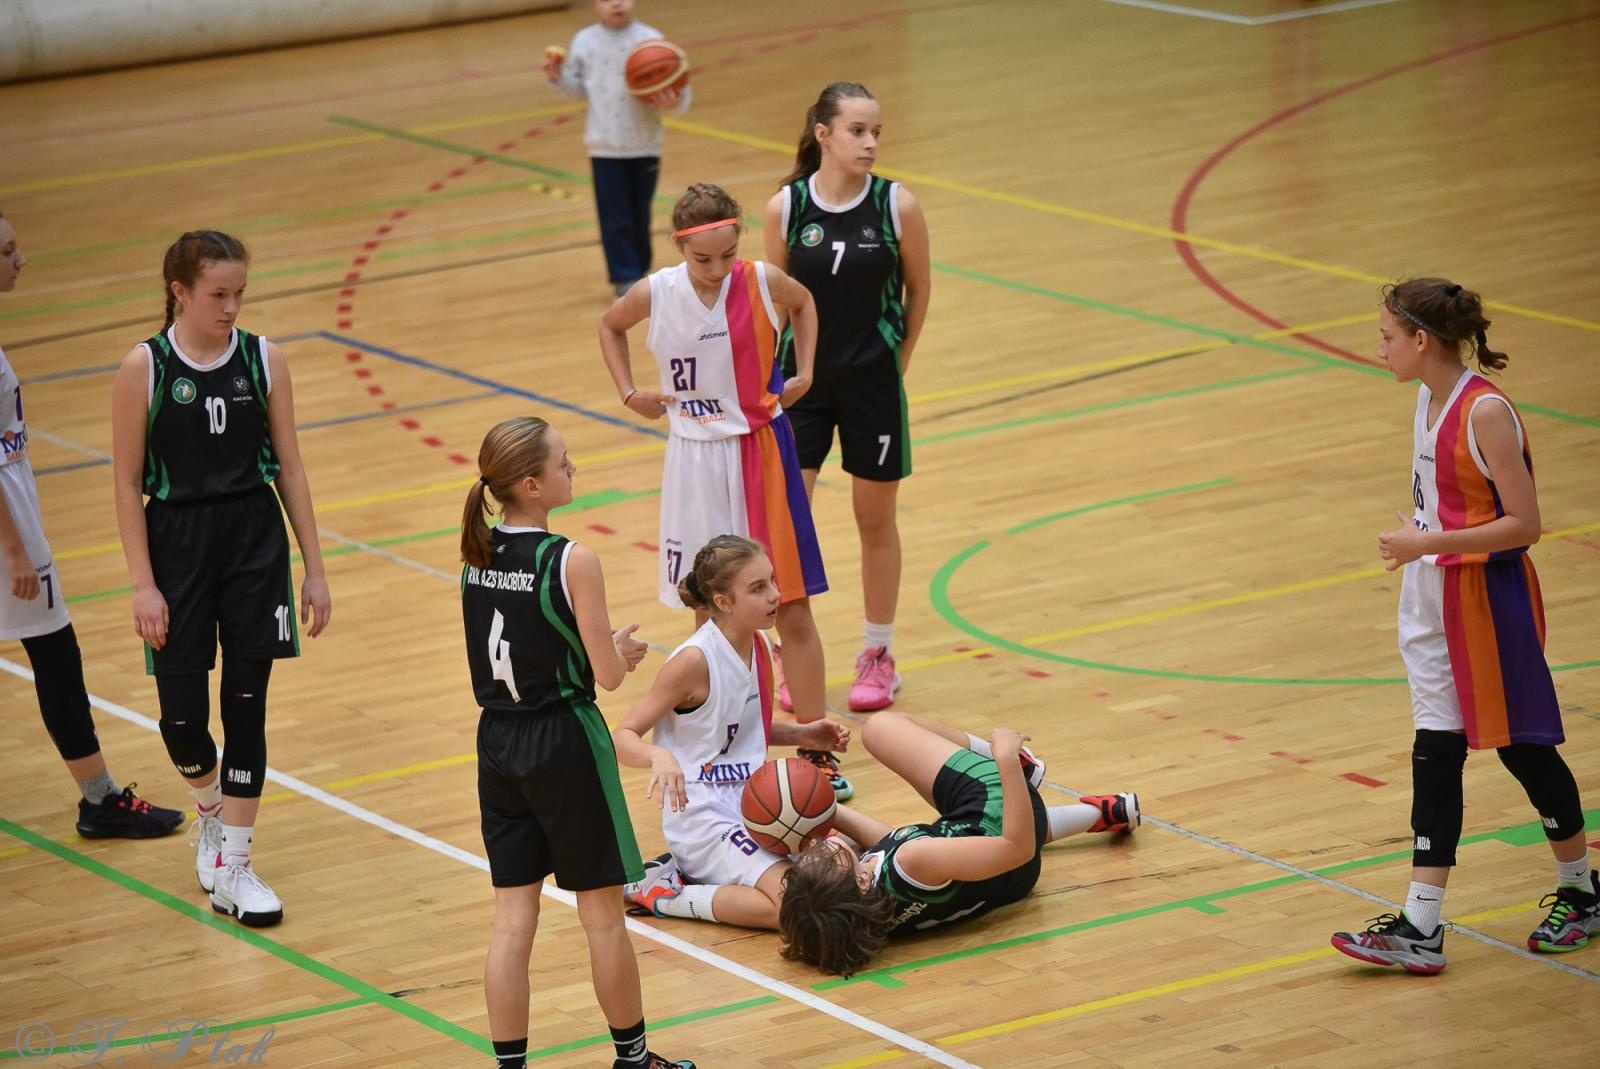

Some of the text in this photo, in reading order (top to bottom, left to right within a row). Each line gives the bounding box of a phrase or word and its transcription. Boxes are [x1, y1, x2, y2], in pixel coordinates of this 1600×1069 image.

[832, 241, 846, 275] 7
[670, 357, 697, 392] 27
[205, 396, 227, 435] 10
[878, 434, 891, 466] 7
[481, 568, 497, 589] AZS
[274, 604, 291, 642] 10
[488, 607, 522, 703] 4
[234, 768, 252, 785] NBA
[697, 762, 751, 782] MINI
[730, 829, 760, 856] 5
[1416, 836, 1431, 851] NBA
